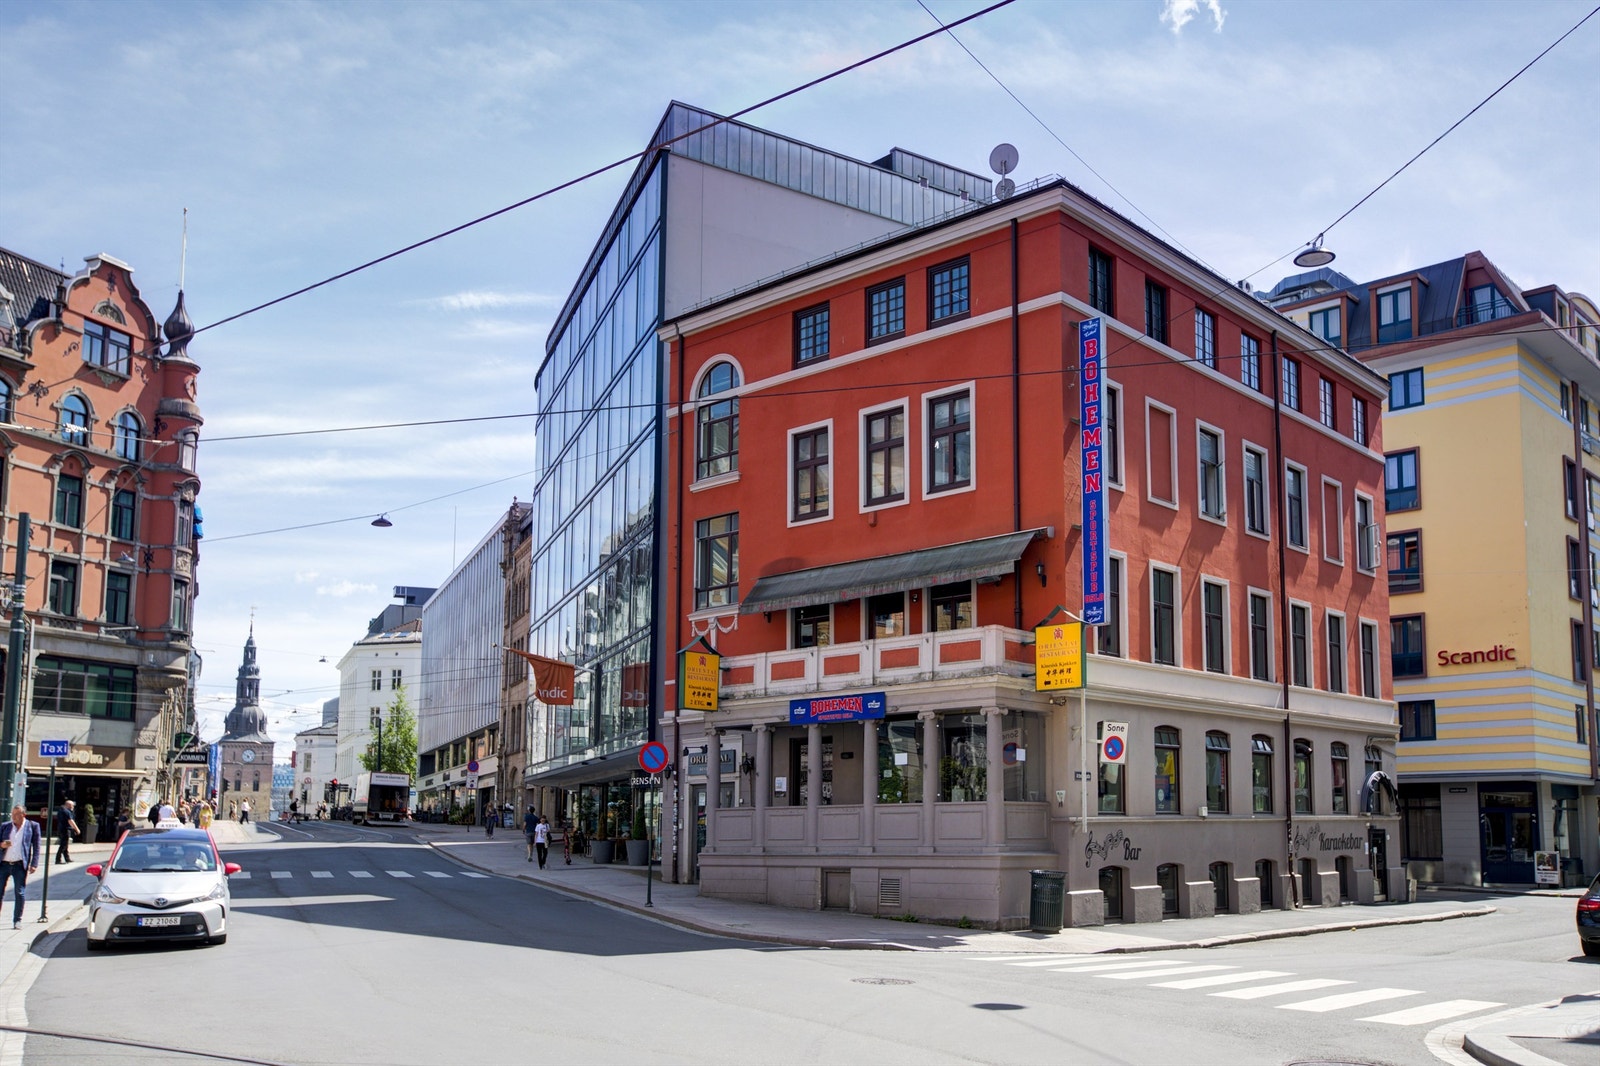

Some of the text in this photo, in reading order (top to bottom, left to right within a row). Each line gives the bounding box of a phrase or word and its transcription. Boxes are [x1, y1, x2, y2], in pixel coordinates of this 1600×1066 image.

[1083, 338, 1101, 493] BOHEMEN
[1089, 500, 1098, 593] SPORTSPUB
[1038, 641, 1077, 649] ORIENTAL
[1039, 649, 1078, 658] RESTAURANT
[1437, 644, 1516, 666] Scandic
[687, 666, 717, 675] ORIENTAL
[687, 674, 717, 682] RESTAURANT
[810, 697, 863, 717] BOHEMEN
[1107, 723, 1125, 732] Sone
[42, 743, 67, 753] Taxi
[1319, 832, 1363, 851] Karaokebar
[1123, 837, 1142, 861] Bar
[156, 917, 178, 925] 21068
